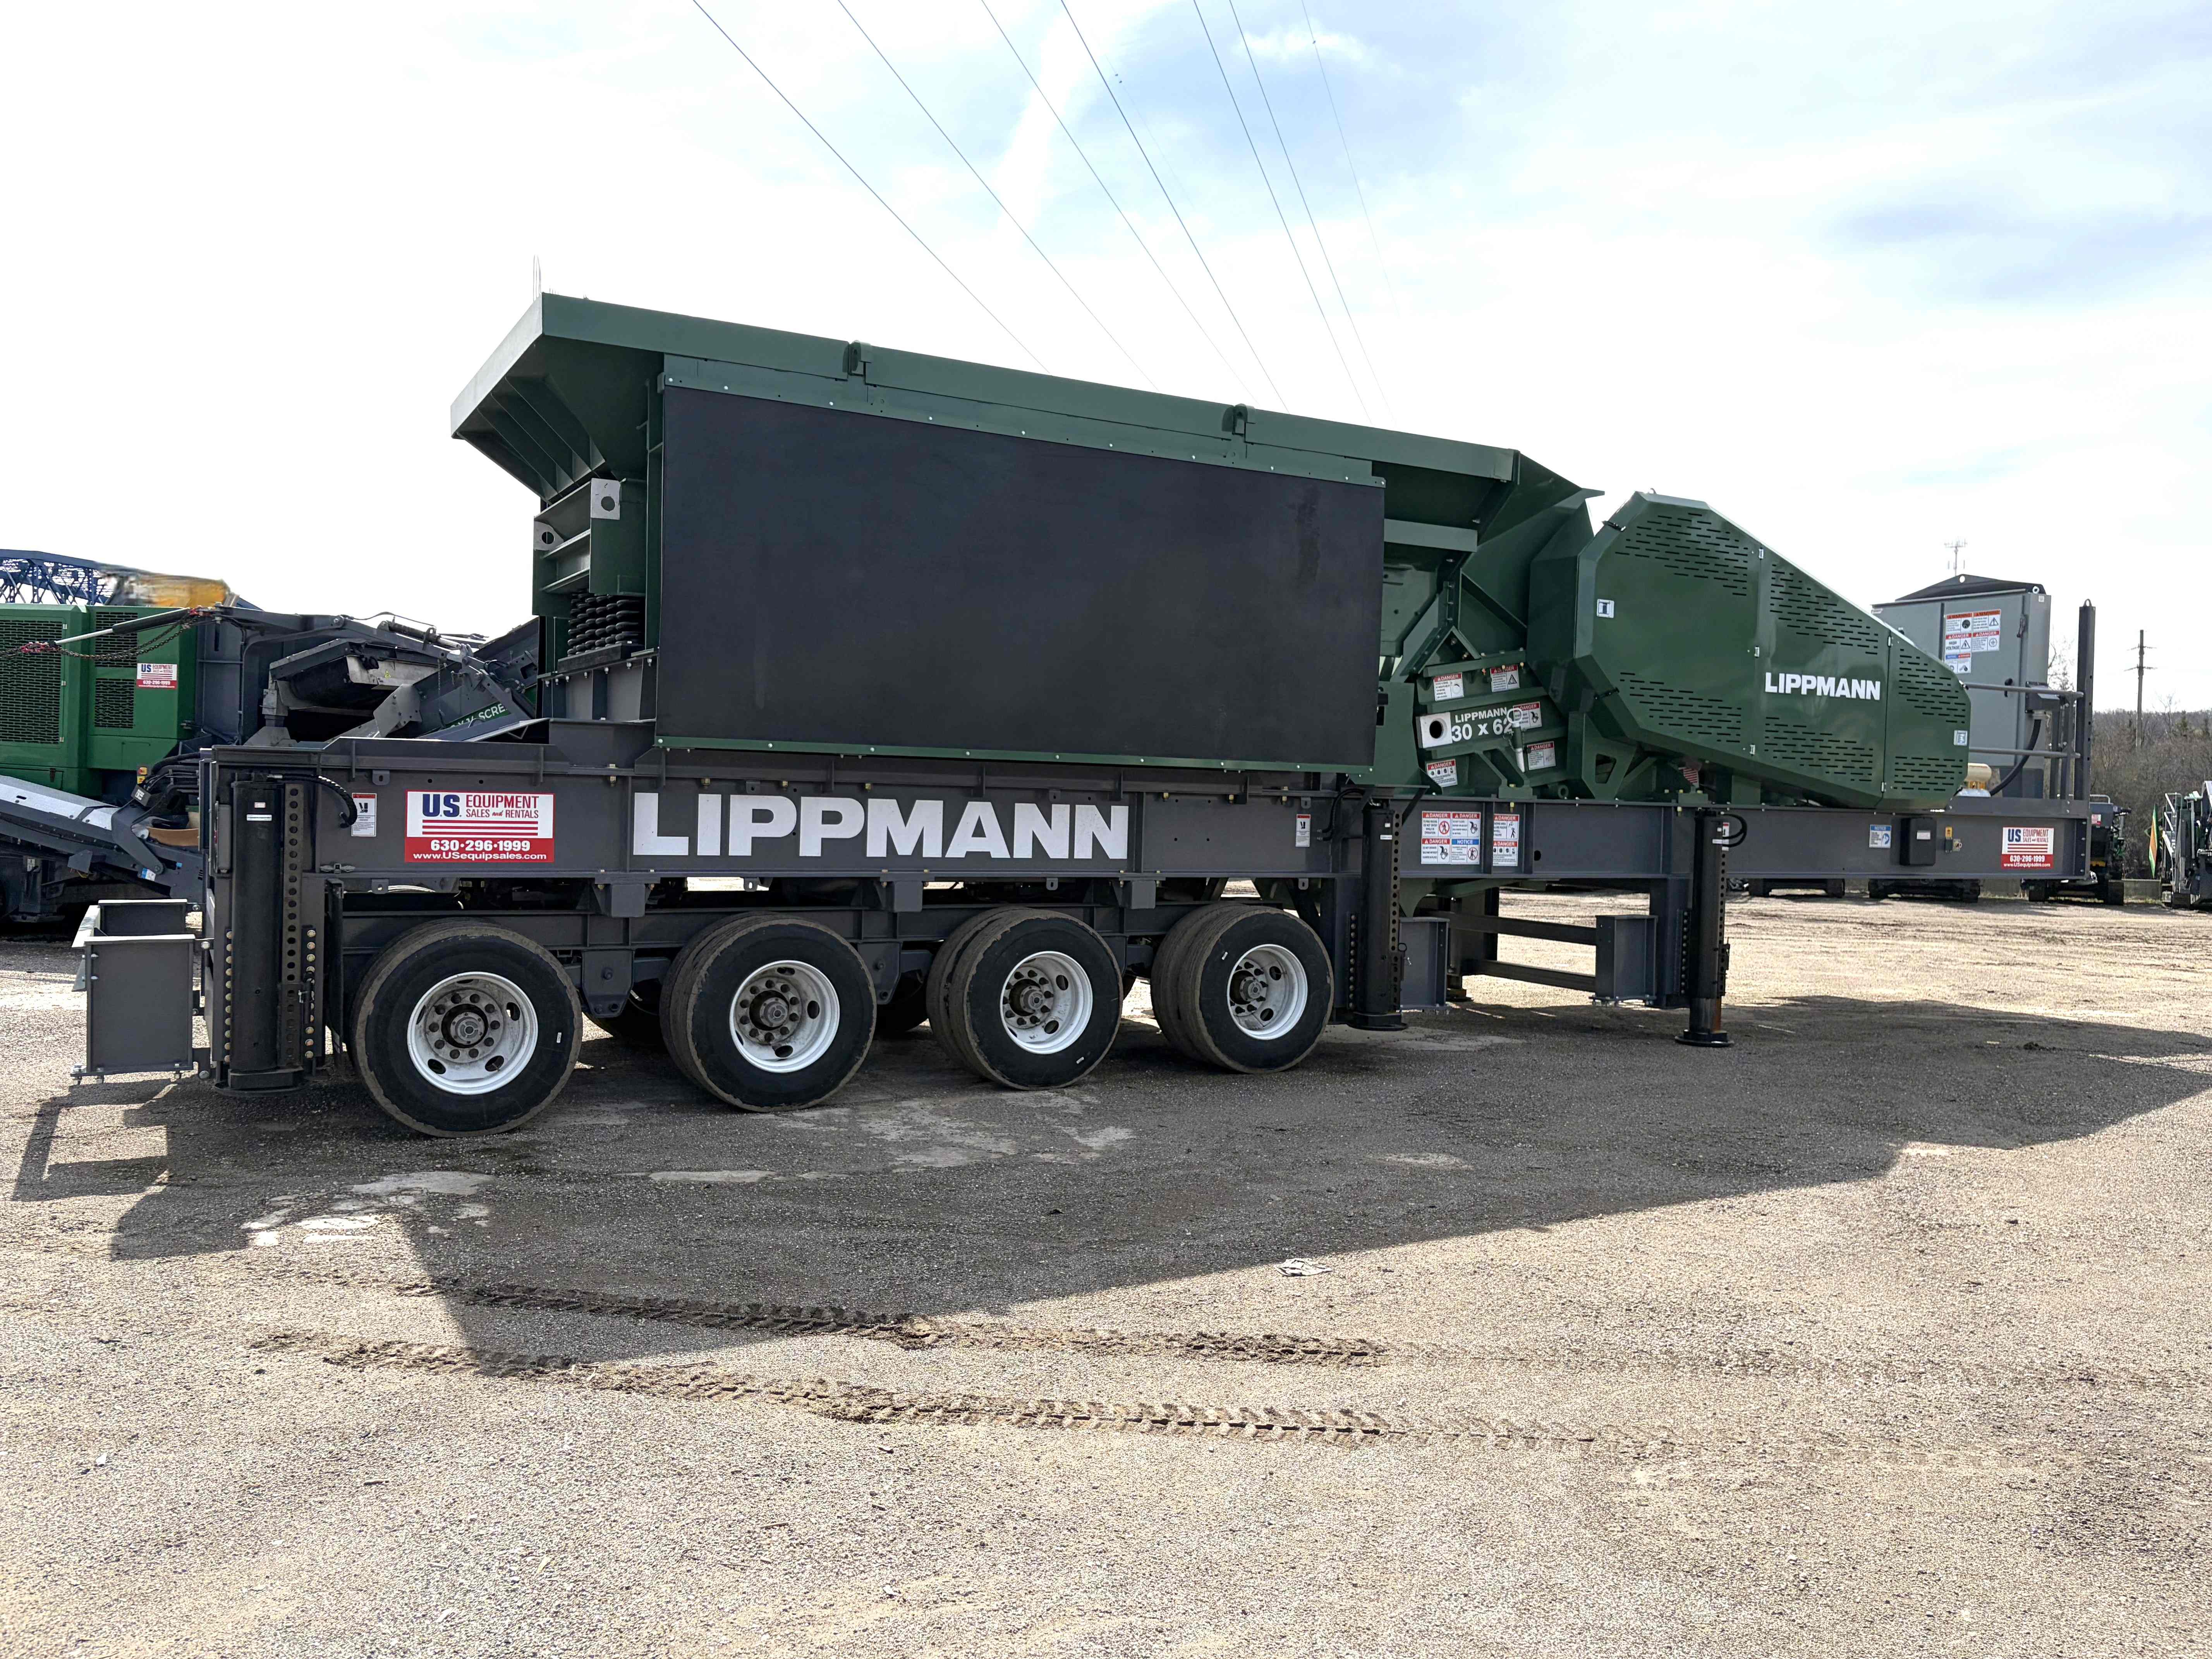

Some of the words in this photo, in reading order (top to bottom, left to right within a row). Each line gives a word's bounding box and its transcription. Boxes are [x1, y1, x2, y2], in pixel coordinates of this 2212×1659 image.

[1765, 672, 1881, 700] LIPPMANN
[479, 703, 508, 720] SCRE
[1455, 707, 1507, 723] LIPPMANN
[1451, 723, 1472, 742] 30
[1493, 719, 1513, 735] 62
[466, 794, 539, 809] EQUIPMENT
[465, 809, 490, 817] SALES
[505, 809, 539, 818] RENTALS
[633, 792, 1129, 860] LIPPMANN
[2023, 829, 2049, 837] EQUIPMENT
[413, 852, 547, 860] www.USequipsales.com
